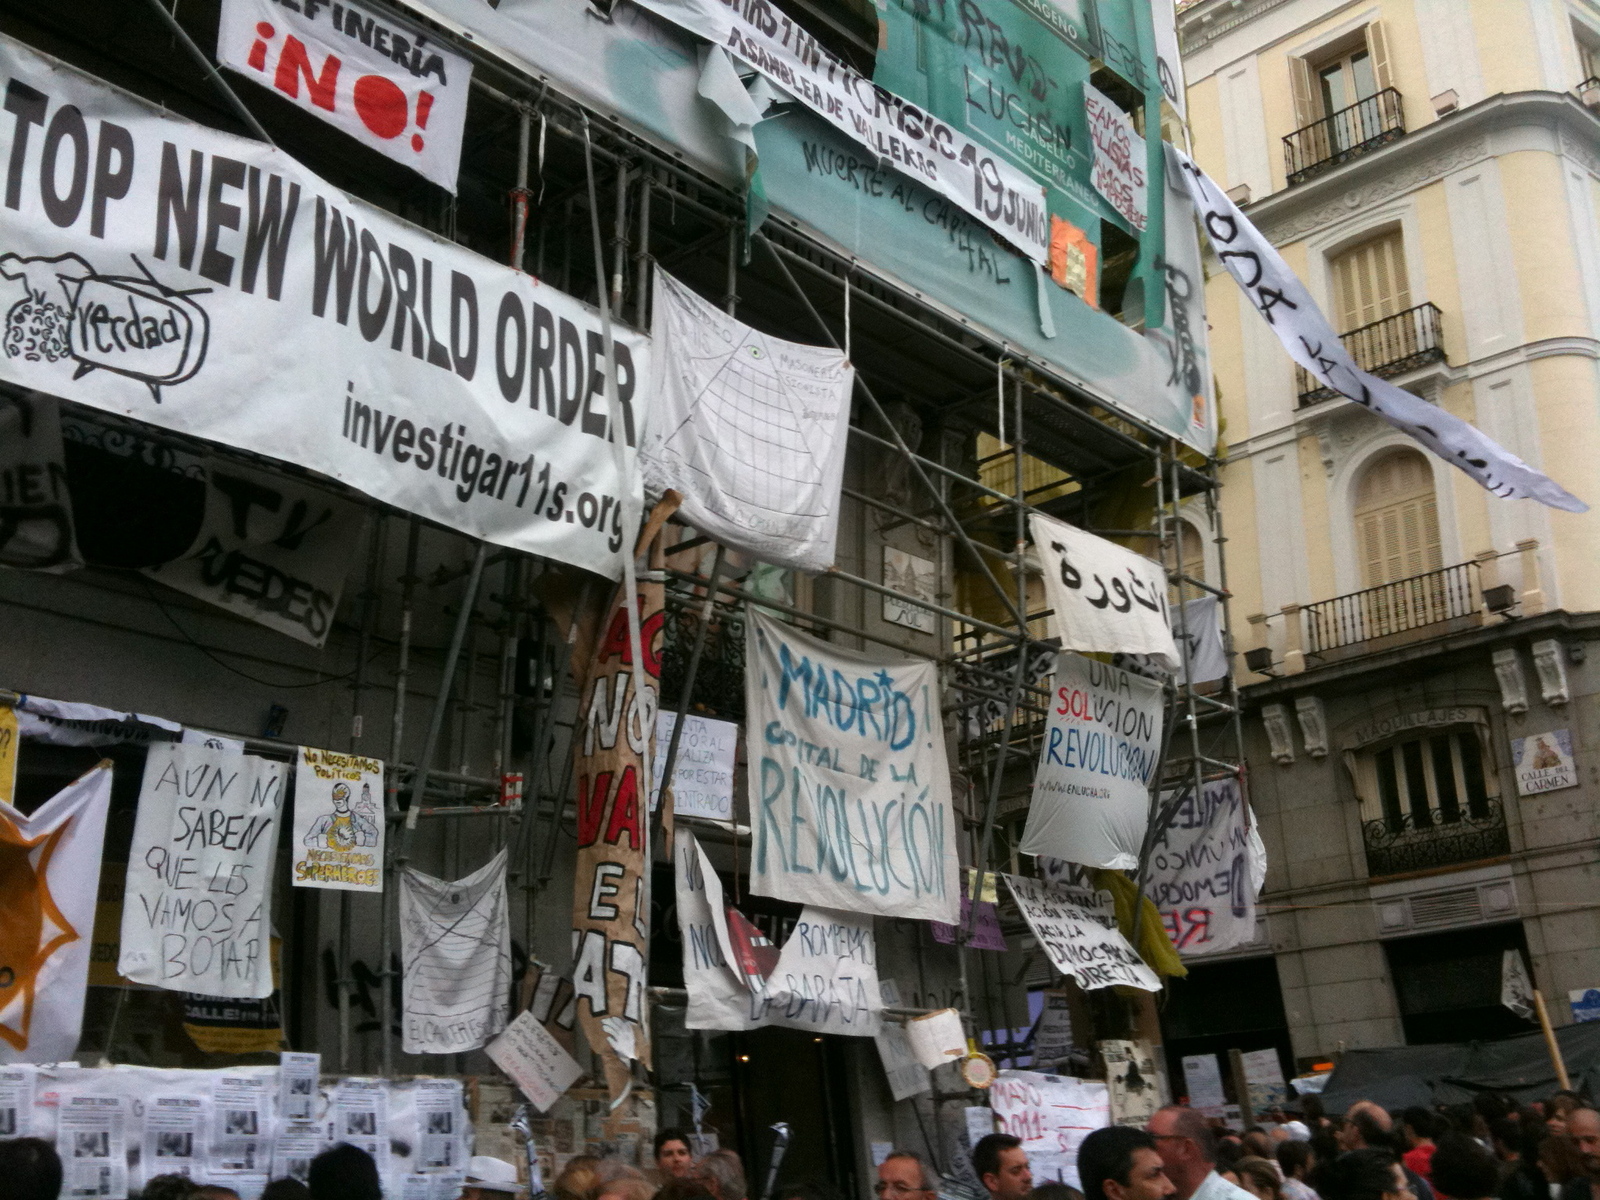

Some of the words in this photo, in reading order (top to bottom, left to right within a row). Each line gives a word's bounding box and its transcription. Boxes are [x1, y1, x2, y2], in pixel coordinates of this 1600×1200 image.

[827, 97, 844, 121] DE
[1004, 188, 1047, 248] JUNIO
[153, 140, 301, 302] NEW
[312, 194, 479, 382] WORLD
[495, 291, 637, 449] ORDER
[342, 380, 624, 554] investigar11s.org
[1088, 659, 1132, 700] UNA
[583, 670, 657, 756] NO
[155, 761, 238, 802] AÚN
[859, 753, 881, 782] DE
[890, 761, 918, 787] LA
[1521, 769, 1550, 782] CALLE
[1525, 775, 1570, 793] CARMEN
[173, 806, 273, 855] SABEN
[757, 755, 947, 901] REVOLUCIÓN
[145, 846, 198, 891] QUE
[207, 861, 254, 897] LES
[139, 891, 236, 934] VAMOS
[161, 931, 264, 982] BOTAR
[786, 974, 871, 1027] BARAJA
